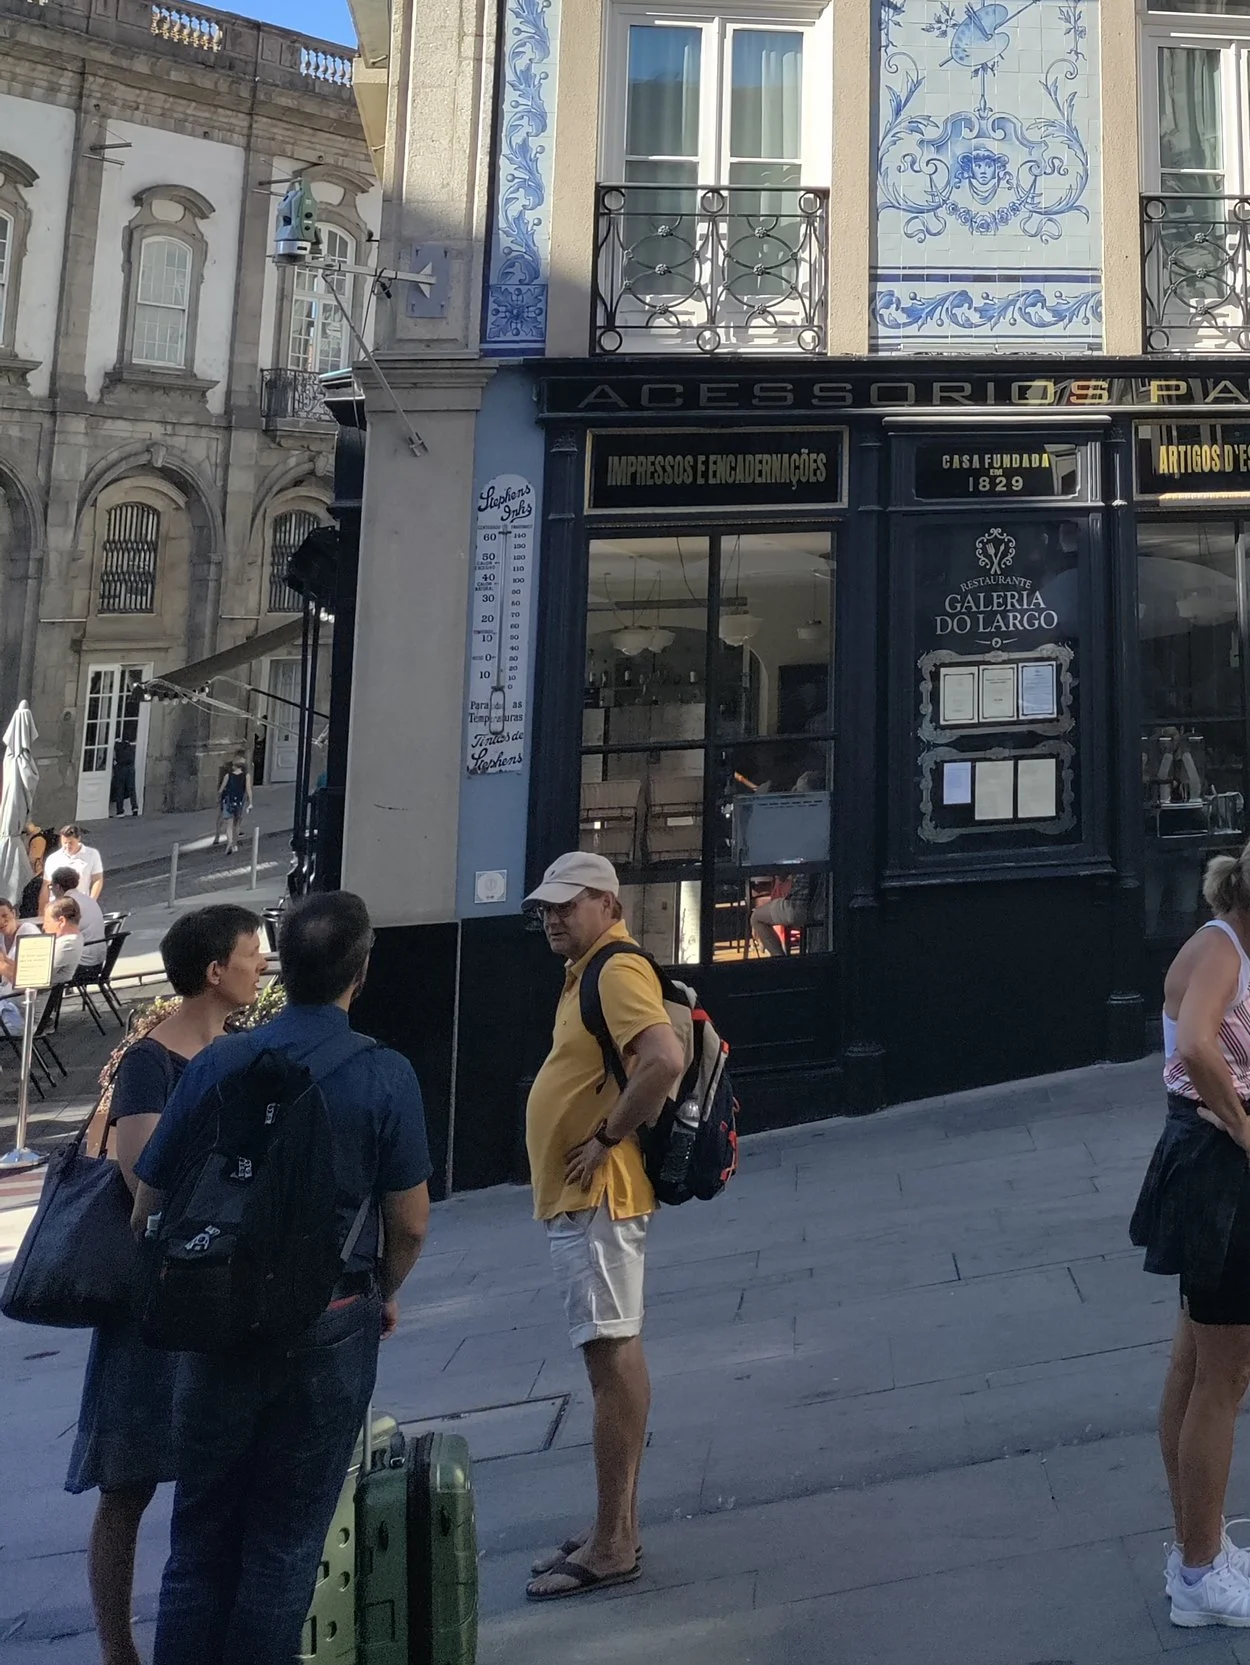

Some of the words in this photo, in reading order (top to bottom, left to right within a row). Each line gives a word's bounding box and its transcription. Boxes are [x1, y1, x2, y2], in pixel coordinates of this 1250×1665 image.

[578, 378, 1109, 409] ACESSORIOS
[942, 453, 982, 469] CASA
[984, 452, 1050, 468] FUNDADA
[1159, 444, 1221, 475] ARTIGOS
[607, 453, 694, 487] IMPRESSOS
[697, 454, 706, 485] E
[708, 449, 827, 491] ENCADERNAÇÕES
[969, 475, 1025, 493] 1829
[478, 484, 531, 512] Stephens
[500, 499, 533, 524] Inks
[483, 533, 497, 542] 60
[482, 552, 496, 561] 50
[481, 573, 496, 582] 40
[960, 575, 1033, 592] RESTAURANTE
[482, 594, 495, 603] 30
[944, 590, 1047, 613] GALERIA
[481, 615, 494, 623] 20
[935, 615, 972, 635] DO
[977, 610, 1058, 633] LARGO
[481, 635, 493, 643] 10
[479, 670, 491, 679] 10
[470, 701, 489, 710] Para
[467, 748, 523, 774] Stephens
